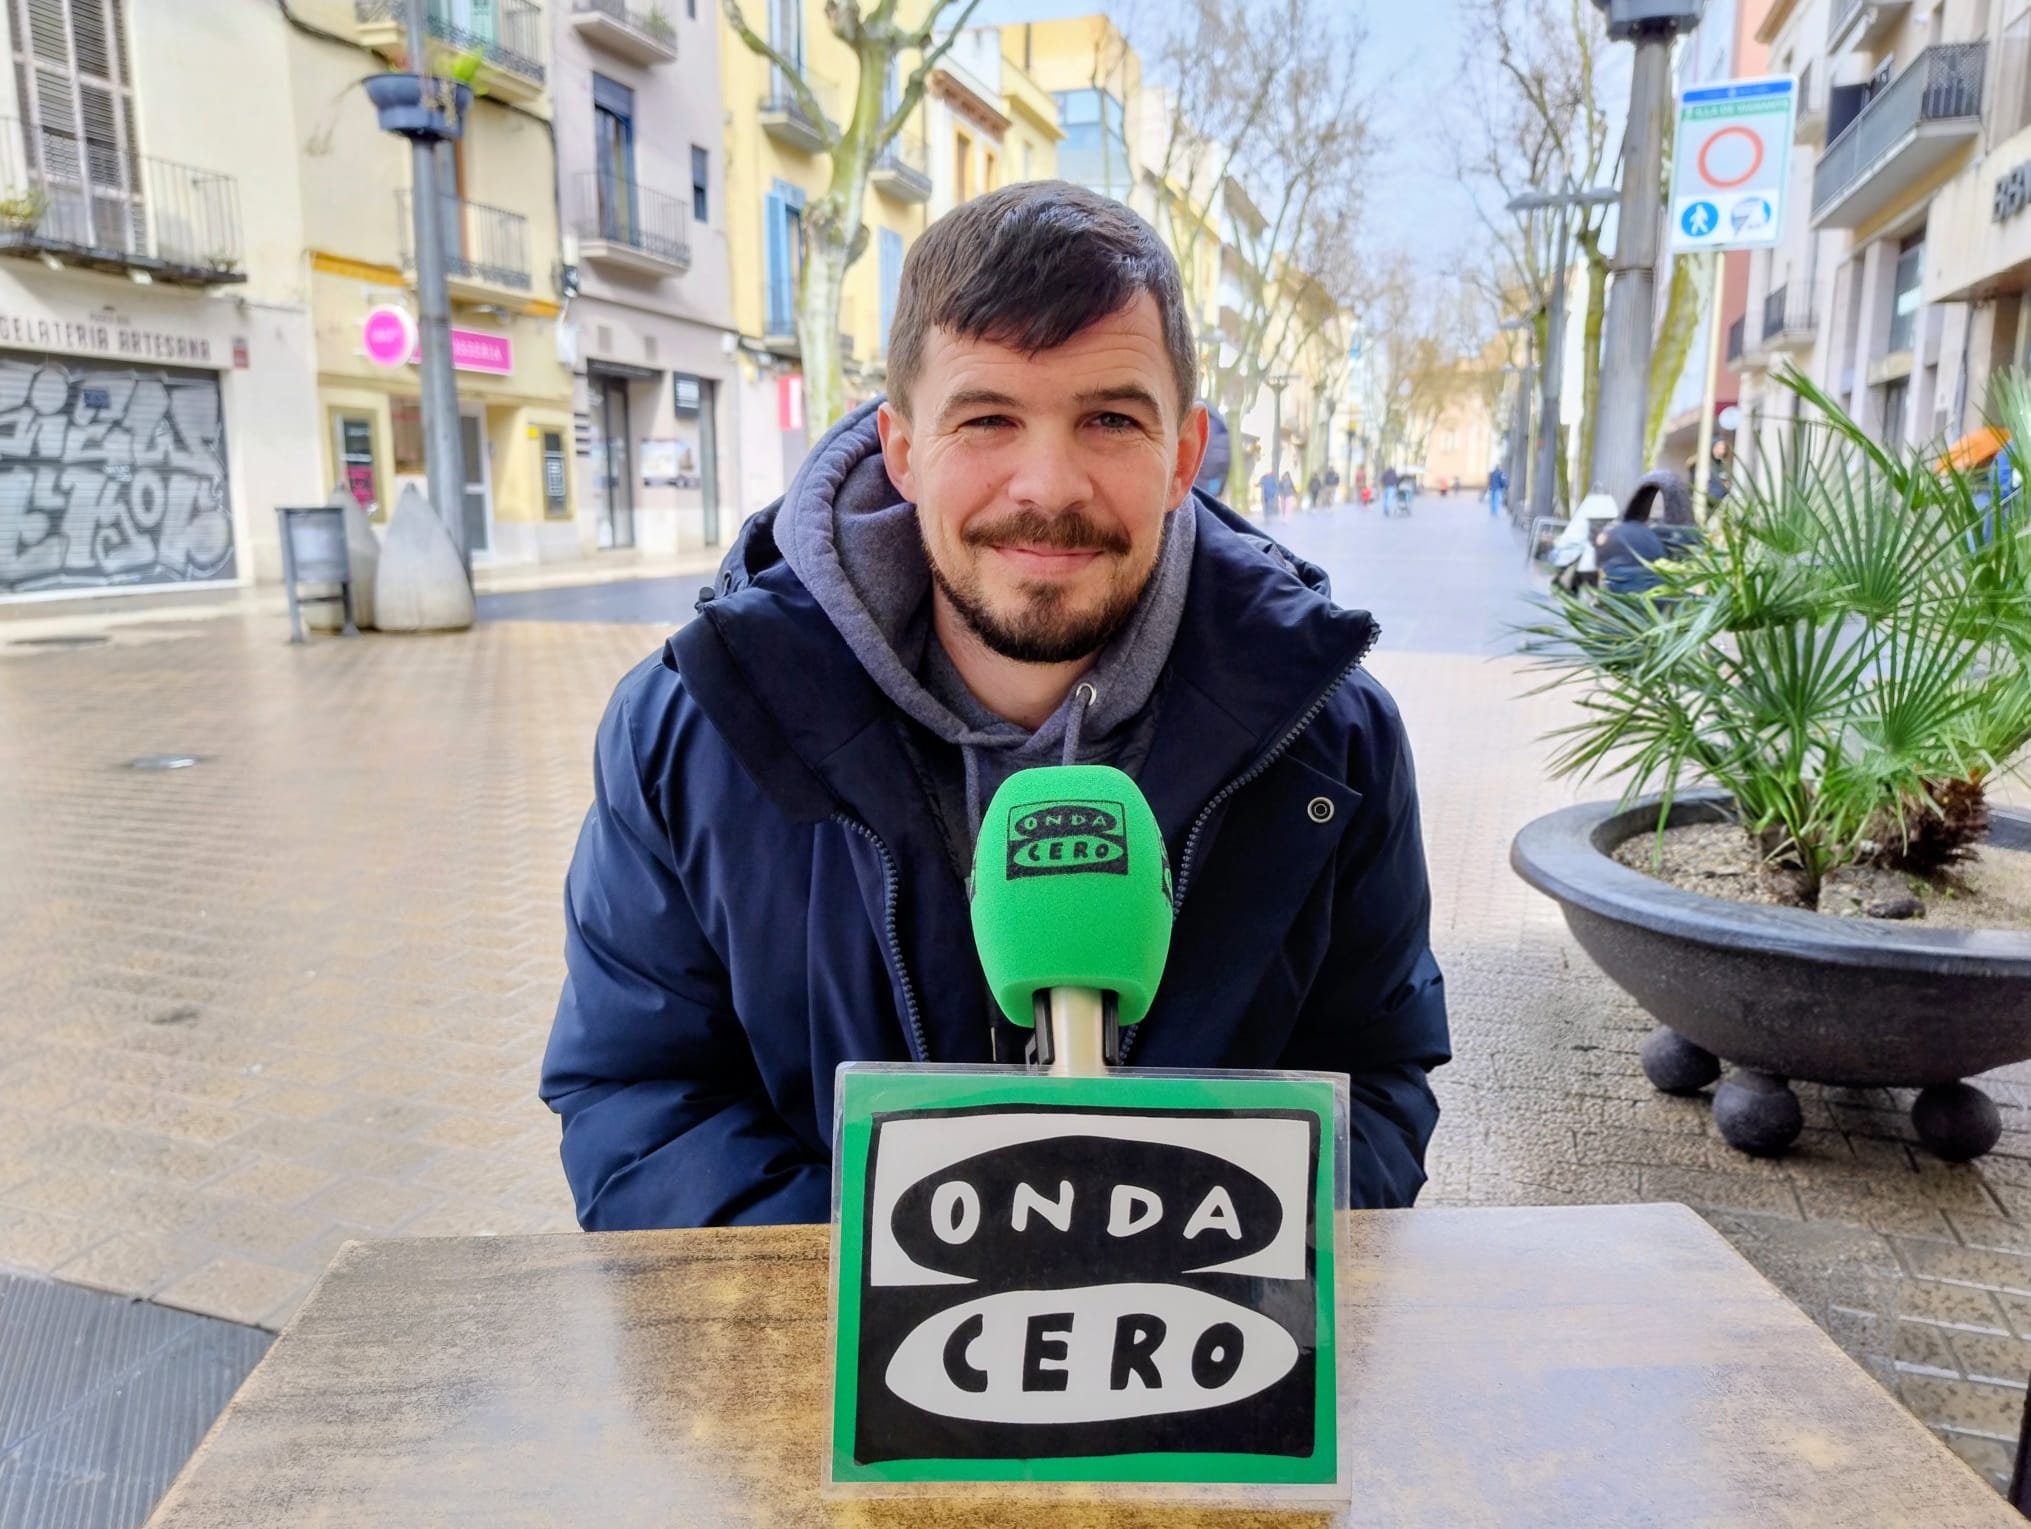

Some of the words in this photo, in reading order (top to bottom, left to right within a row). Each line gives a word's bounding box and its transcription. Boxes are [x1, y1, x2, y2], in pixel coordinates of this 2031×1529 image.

[1992, 159, 2031, 223] BB
[0, 317, 110, 350] GELATERIA
[118, 330, 212, 361] ARTESANA
[1023, 814, 1107, 831] ONDA
[1028, 841, 1110, 862] CERO
[930, 1179, 1242, 1245] ONDA
[942, 1312, 1245, 1393] CERO
